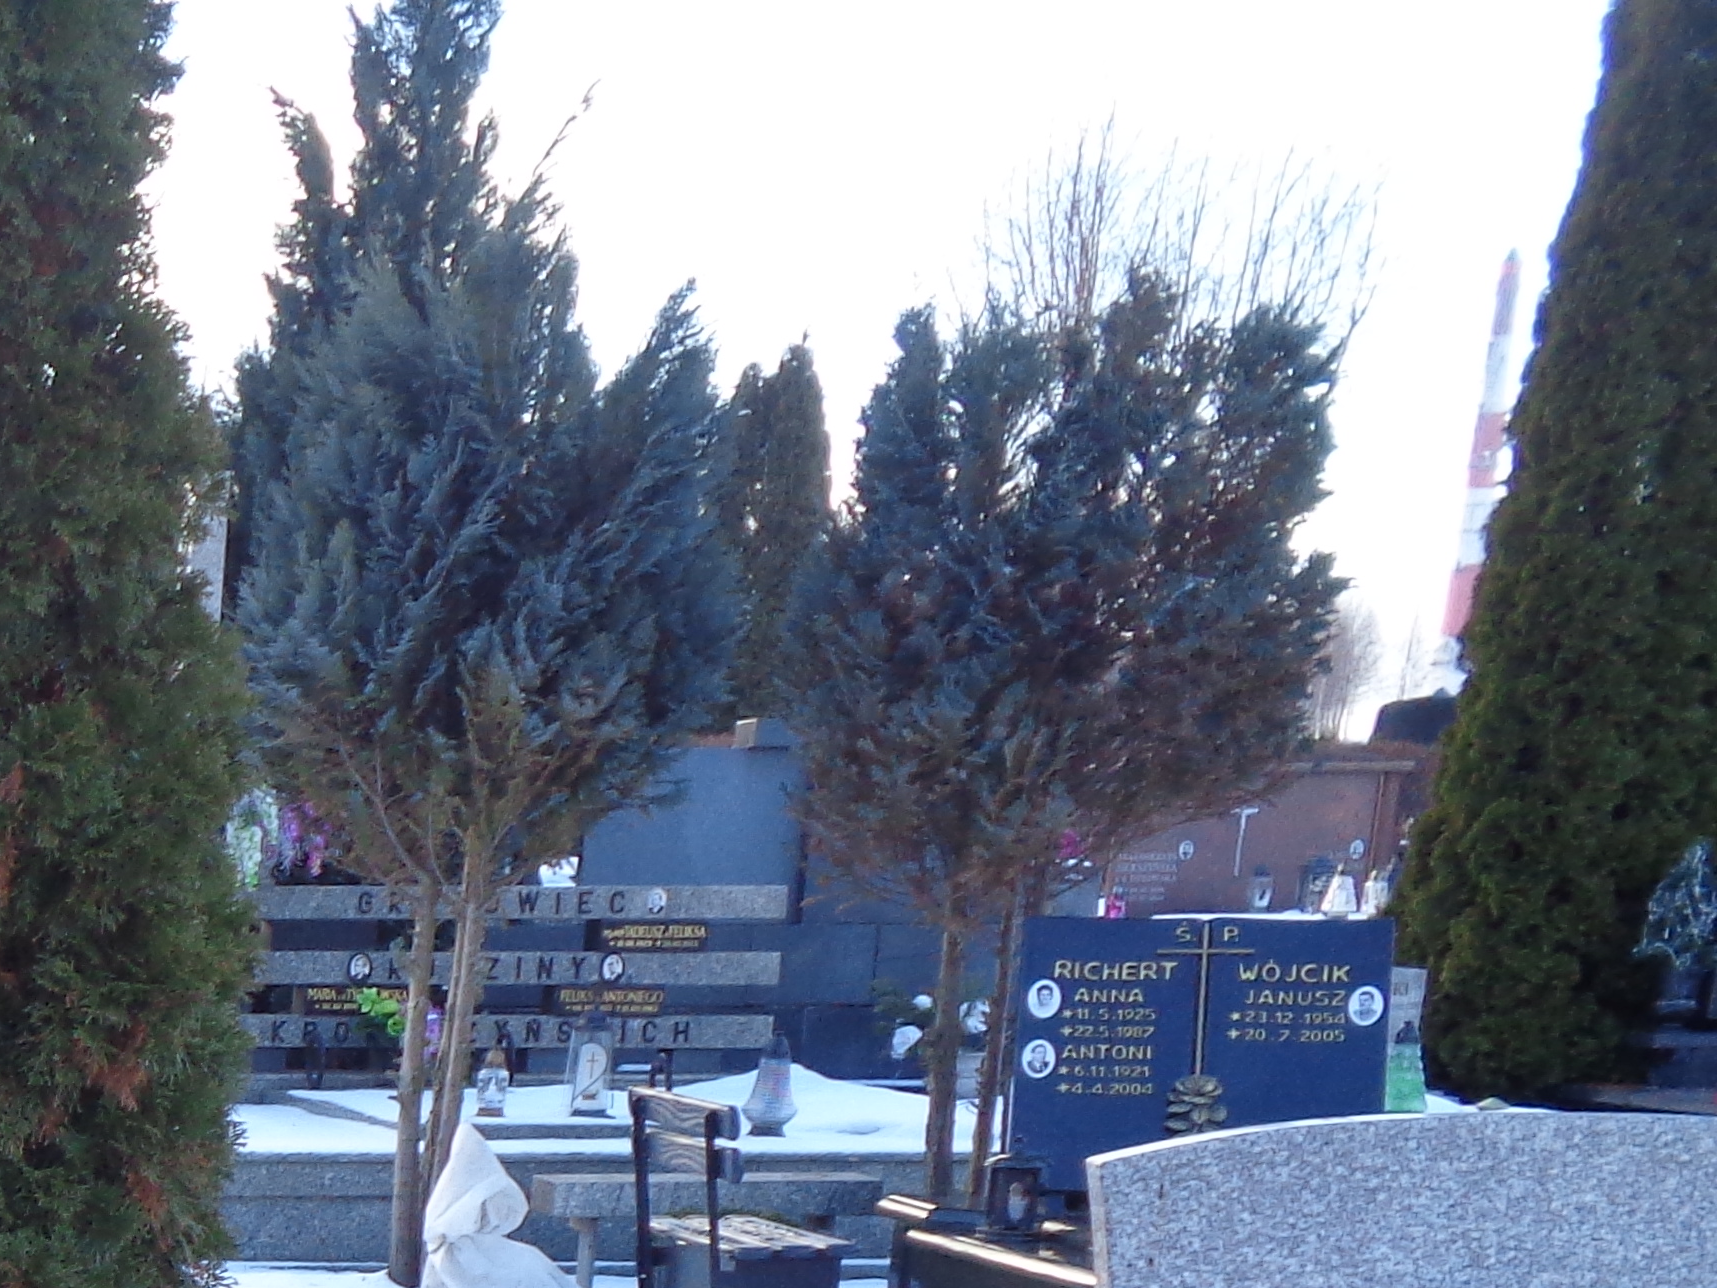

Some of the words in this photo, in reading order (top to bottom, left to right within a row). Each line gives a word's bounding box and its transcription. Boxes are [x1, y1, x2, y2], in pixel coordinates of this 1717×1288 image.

[1053, 960, 1179, 981] RICHERT
[1238, 959, 1351, 983] WÓJCIK
[1074, 988, 1145, 1002] ANNA
[1245, 989, 1346, 1006] JANUSZ
[1061, 1044, 1153, 1060] ANTONI
